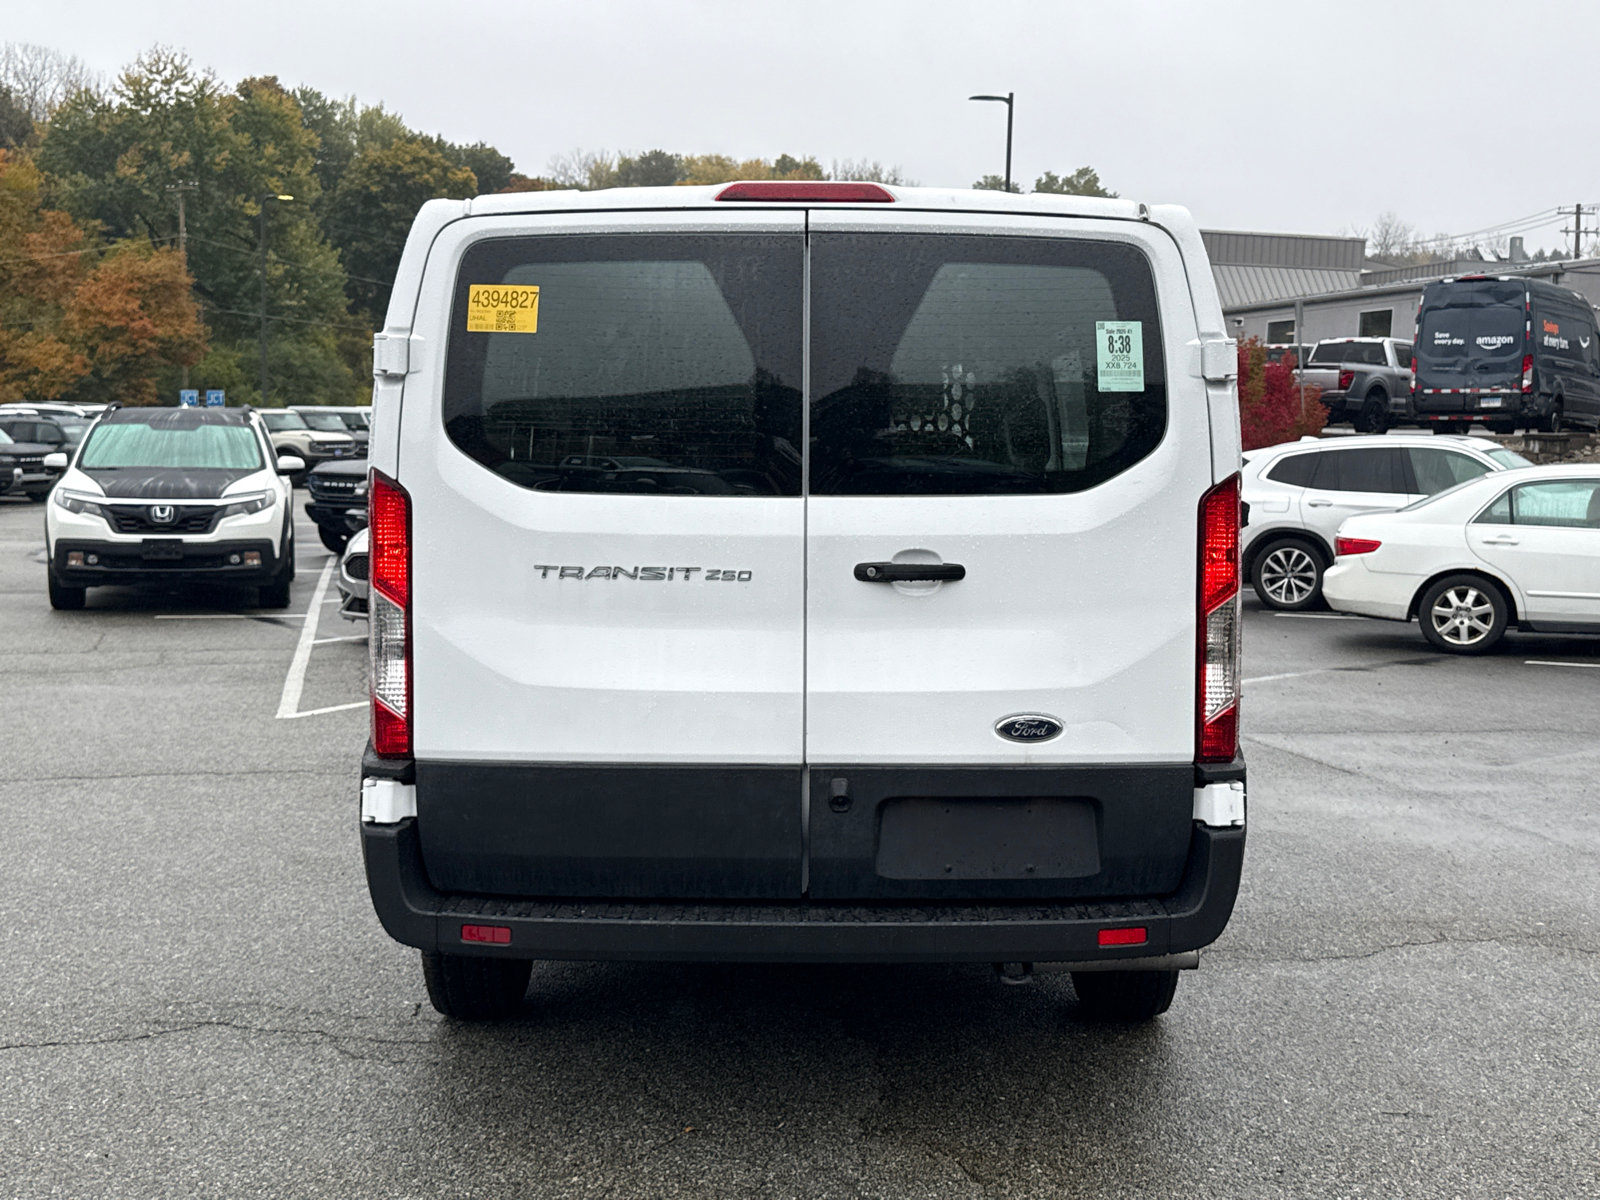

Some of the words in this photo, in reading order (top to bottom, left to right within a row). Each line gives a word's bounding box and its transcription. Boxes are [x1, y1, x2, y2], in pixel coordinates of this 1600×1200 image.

[471, 290, 539, 309] 4394827
[1108, 335, 1131, 354] 8:38
[1476, 335, 1514, 345] amazon
[534, 564, 702, 581] TRANSIT
[704, 569, 752, 582] 250
[1011, 720, 1048, 736] Ford
